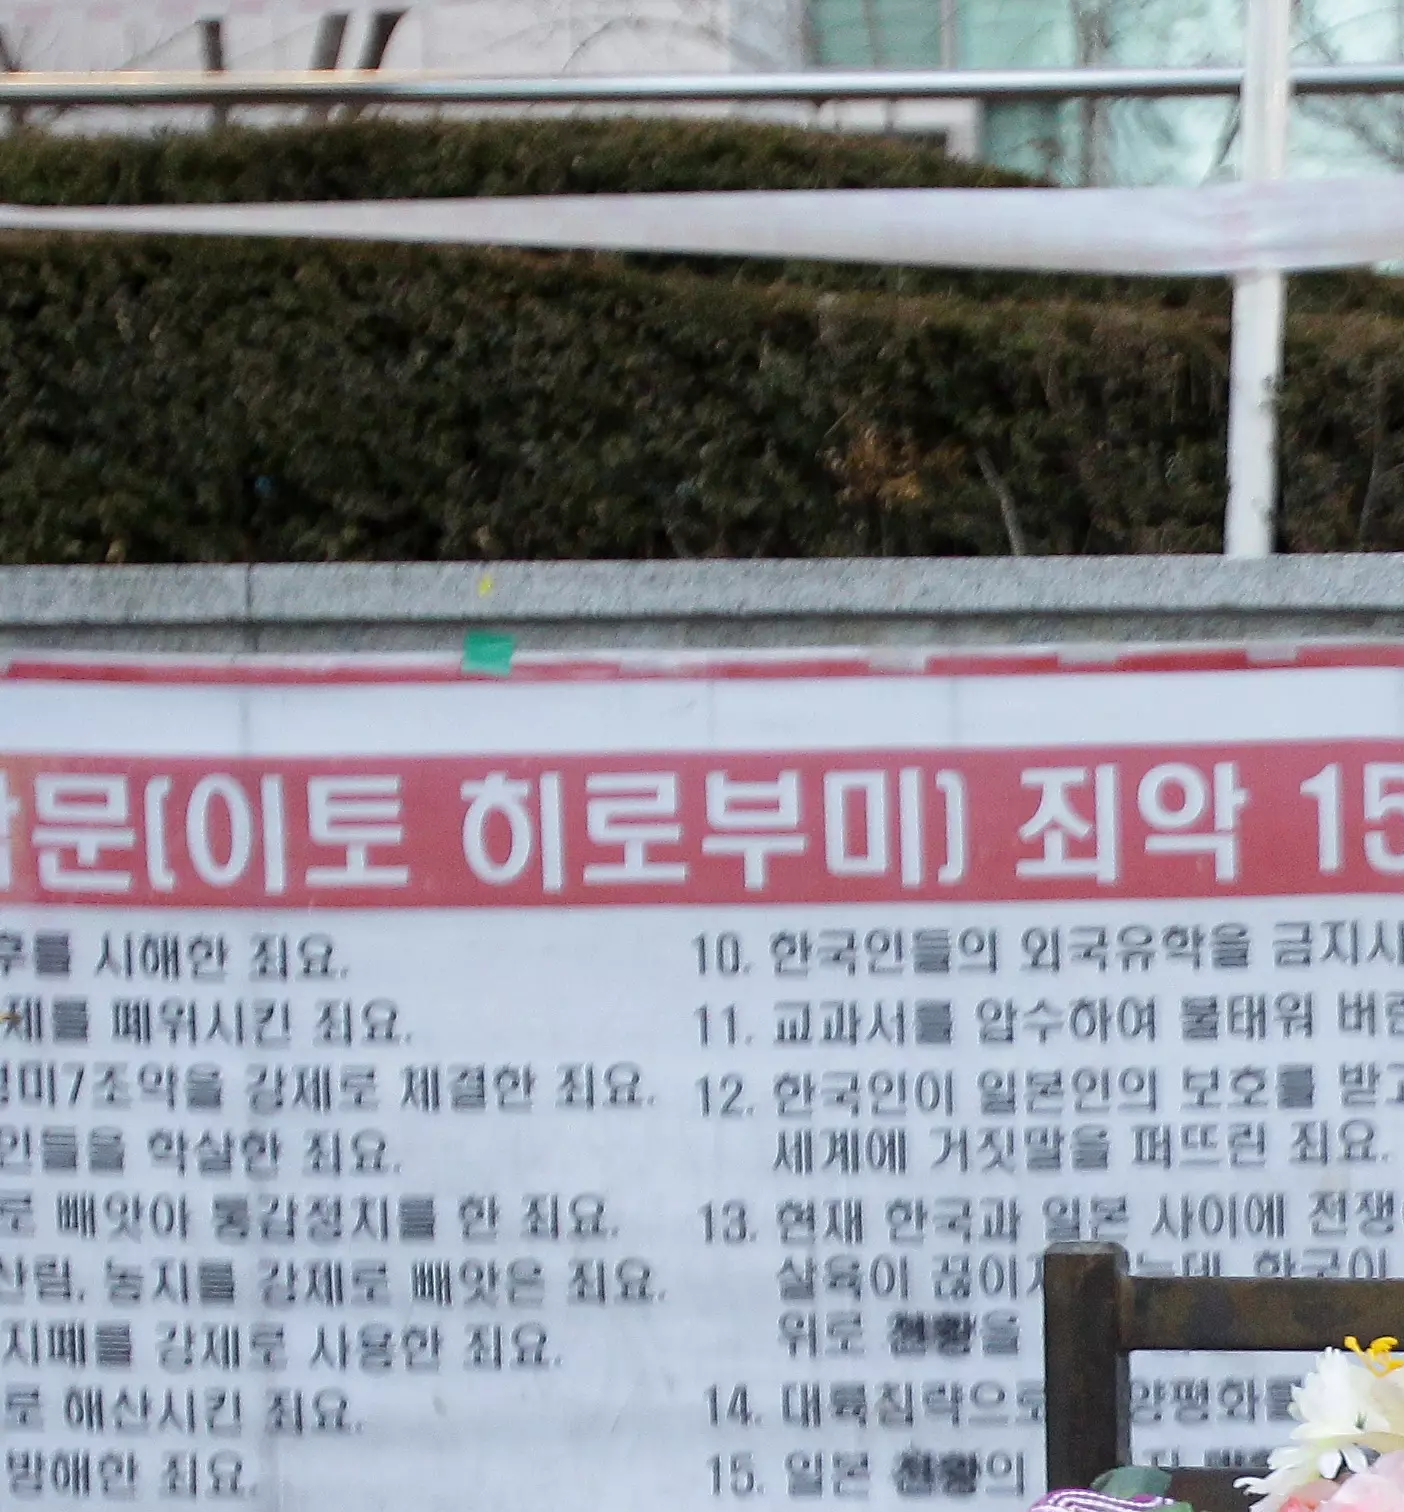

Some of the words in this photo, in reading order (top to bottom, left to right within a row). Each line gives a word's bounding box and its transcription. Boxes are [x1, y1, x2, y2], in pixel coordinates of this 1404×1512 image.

[0, 768, 410, 896] 문(이토
[457, 765, 970, 895] 히로부미)
[1013, 760, 1249, 886] 죄악
[96, 933, 228, 980] 시해한
[250, 933, 348, 983] 죄요.
[694, 932, 750, 976] 10.
[770, 927, 998, 977] 한국인들의
[1021, 922, 1251, 974] 외국유학을
[113, 999, 290, 1048] 폐위시킨
[316, 1000, 411, 1048] 죄요.
[696, 1004, 752, 1047] 11.
[775, 1000, 953, 1047] 교과서를
[976, 996, 1156, 1045] 압수하여
[1181, 992, 1314, 1041] 불태워
[246, 1065, 377, 1117] 강제로
[401, 1065, 536, 1114] 체결한
[556, 1063, 654, 1111] 죄요.
[696, 1073, 754, 1119] 12.
[773, 1070, 954, 1119] 한국인이
[978, 1067, 1158, 1118] 일본인의
[1183, 1064, 1316, 1112] 보호를
[148, 1127, 281, 1180] 학살한
[304, 1130, 400, 1178] 죄요.
[774, 1128, 907, 1175] 세계에
[931, 1124, 1110, 1175] 거짓말을
[1132, 1123, 1266, 1170] 퍼뜨린
[1290, 1119, 1388, 1168] 죄요.
[57, 1193, 190, 1241] 빼앗아
[213, 1194, 436, 1245] 통감정치를
[458, 1195, 499, 1243] 한
[521, 1195, 618, 1243] 죄요.
[701, 1200, 757, 1245] 13.
[777, 1199, 863, 1246] 현재
[886, 1197, 1022, 1245] 한국과
[1042, 1196, 1129, 1246] 일본
[1152, 1193, 1285, 1241] 사이에
[106, 1259, 236, 1308] 농지를
[259, 1260, 390, 1308] 강제로
[412, 1260, 544, 1308] 빼앗은
[568, 1258, 665, 1307] 죄요.
[777, 1255, 912, 1304] 살육이
[934, 1253, 1043, 1304] 끊이
[4, 1322, 132, 1368] 지폐를
[160, 1322, 287, 1372] 강제로
[310, 1324, 443, 1373] 사용한
[464, 1323, 560, 1371] 죄요.
[779, 1310, 864, 1359] 위로
[64, 1386, 242, 1437] 해산시킨
[262, 1388, 362, 1440] 죄요.
[708, 1384, 761, 1428] 14.
[783, 1382, 1044, 1430] 대륙침략으로
[1131, 1377, 1302, 1426] 양평화를
[7, 1450, 138, 1499] 방해한
[708, 1451, 763, 1499] 15.
[785, 1450, 871, 1498] 일본
